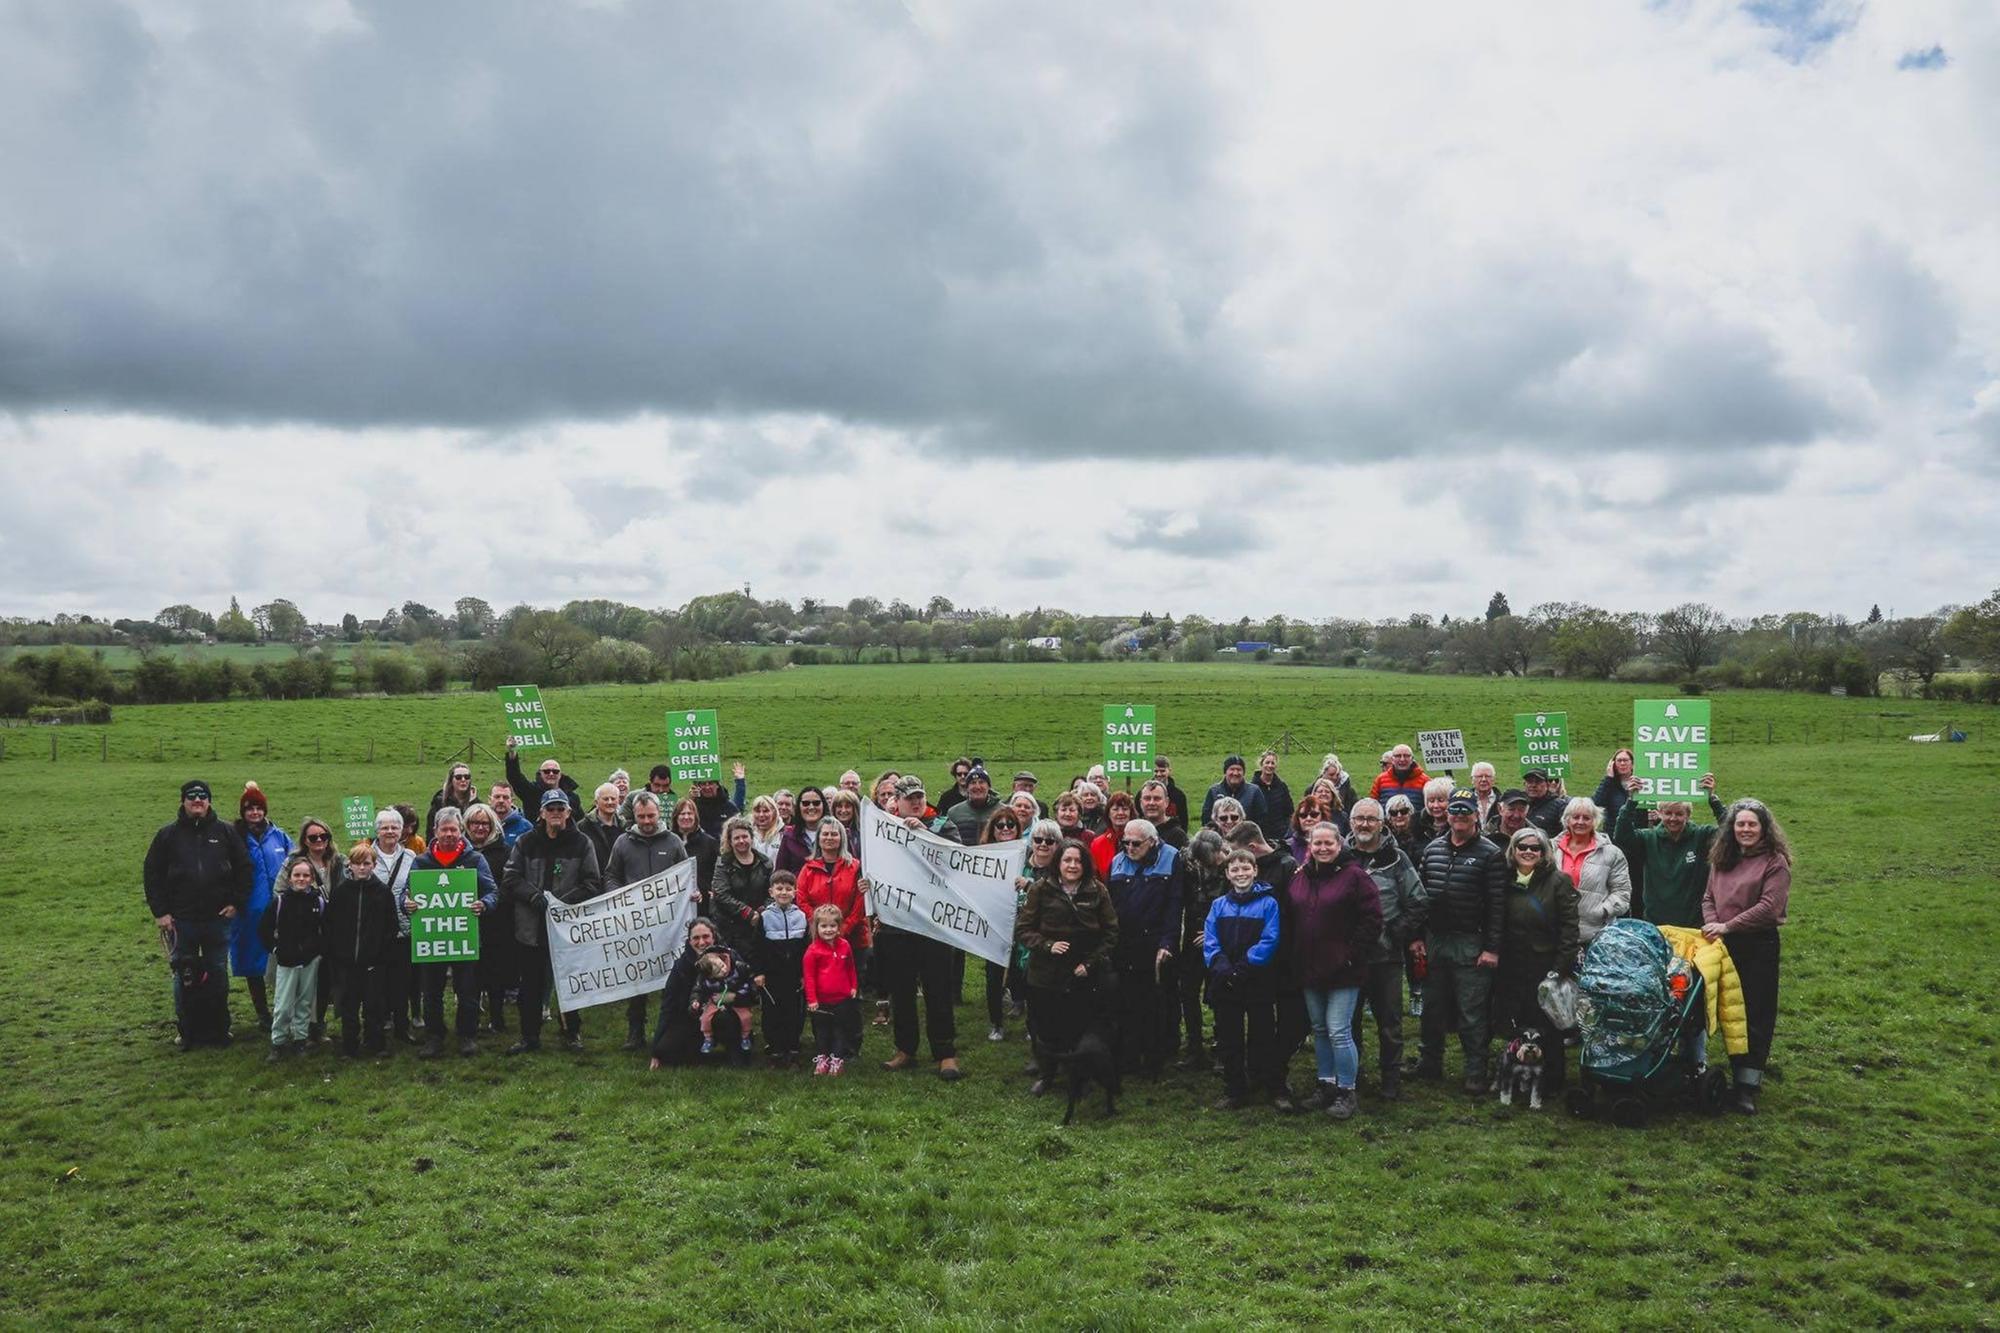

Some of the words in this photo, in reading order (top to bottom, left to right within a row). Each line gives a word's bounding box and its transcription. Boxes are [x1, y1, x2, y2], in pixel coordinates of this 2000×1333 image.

[505, 701, 542, 713] SAVE
[513, 718, 543, 729] THE
[1106, 723, 1152, 735] SAVE
[674, 726, 711, 737] SAVE
[1421, 732, 1443, 742] SAVE
[1443, 731, 1460, 739] THE
[1524, 727, 1561, 737] SAVE
[1638, 726, 1706, 742] SAVE
[514, 734, 551, 745] BELL
[679, 740, 709, 751] OUR
[1431, 740, 1456, 748] BELL
[1112, 742, 1147, 754] THE
[1528, 741, 1559, 751] OUR
[1425, 749, 1447, 757] SAVE
[1520, 754, 1569, 764] GREEN
[671, 754, 718, 765] GREEN
[1645, 752, 1698, 769] THE
[1107, 760, 1152, 772] BELL
[679, 769, 713, 779] BELT
[1639, 778, 1705, 795] BELL
[875, 819, 916, 848] KEEP
[949, 850, 1008, 880] GREEN
[414, 892, 474, 909] SAVE
[550, 905, 595, 923] SAVE
[642, 875, 686, 902] BELL
[871, 881, 916, 912] KITT
[932, 901, 989, 938] GREEN
[421, 916, 468, 932] THE
[570, 914, 627, 944] GREEN
[631, 901, 675, 931] BELT
[416, 940, 475, 956] BELL
[602, 933, 655, 962] FROM
